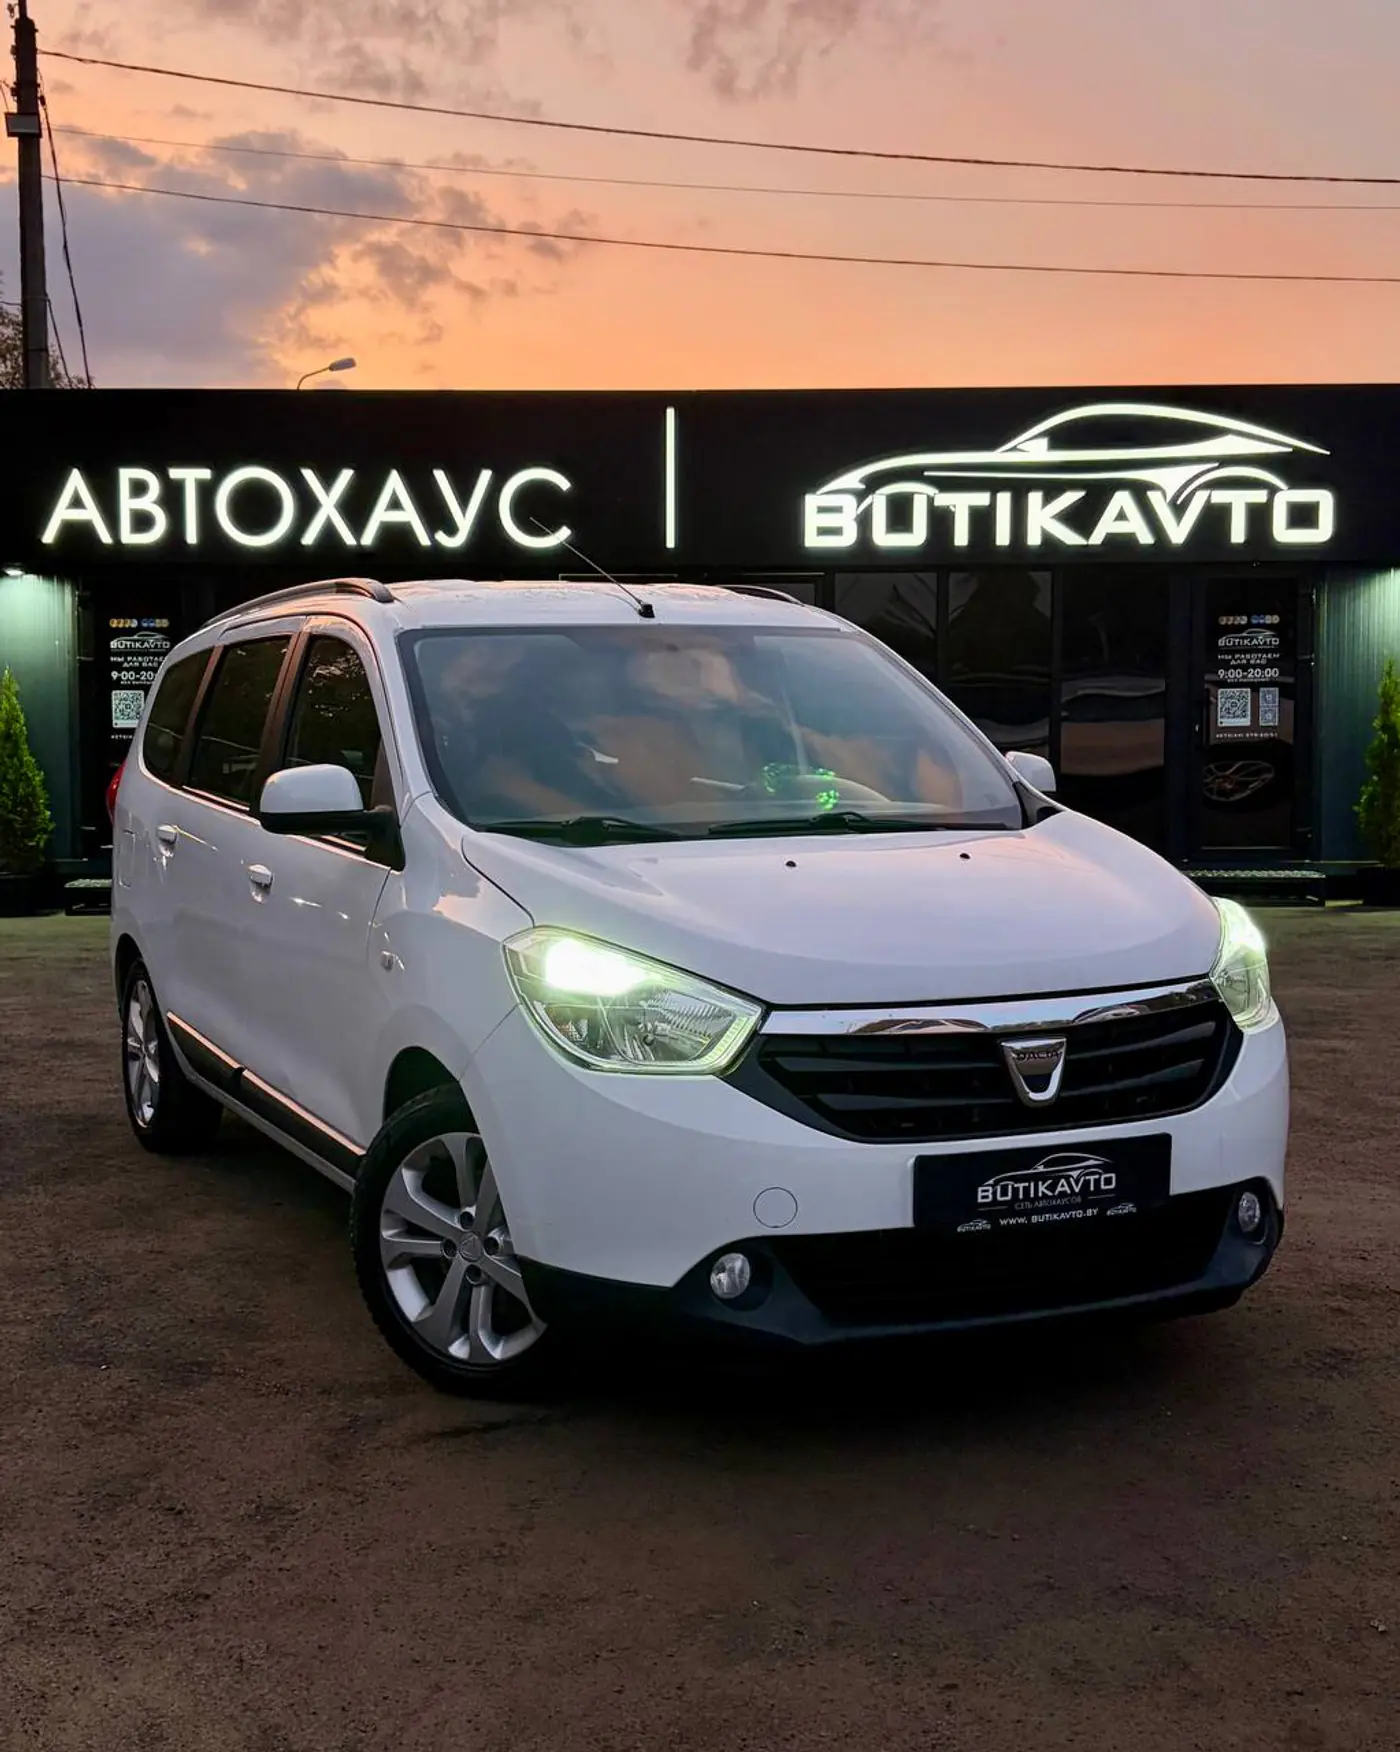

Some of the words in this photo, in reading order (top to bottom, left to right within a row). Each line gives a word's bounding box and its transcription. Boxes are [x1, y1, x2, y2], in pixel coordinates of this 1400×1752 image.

[41, 466, 572, 549] АВТОХАУС
[803, 488, 1336, 549] BUTIKAVTO
[1218, 668, 1280, 679] 9:00-20:00
[977, 1172, 1117, 1204] BUTIKAVTO
[1031, 1208, 1099, 1224] BUTIKAVTO.BY
